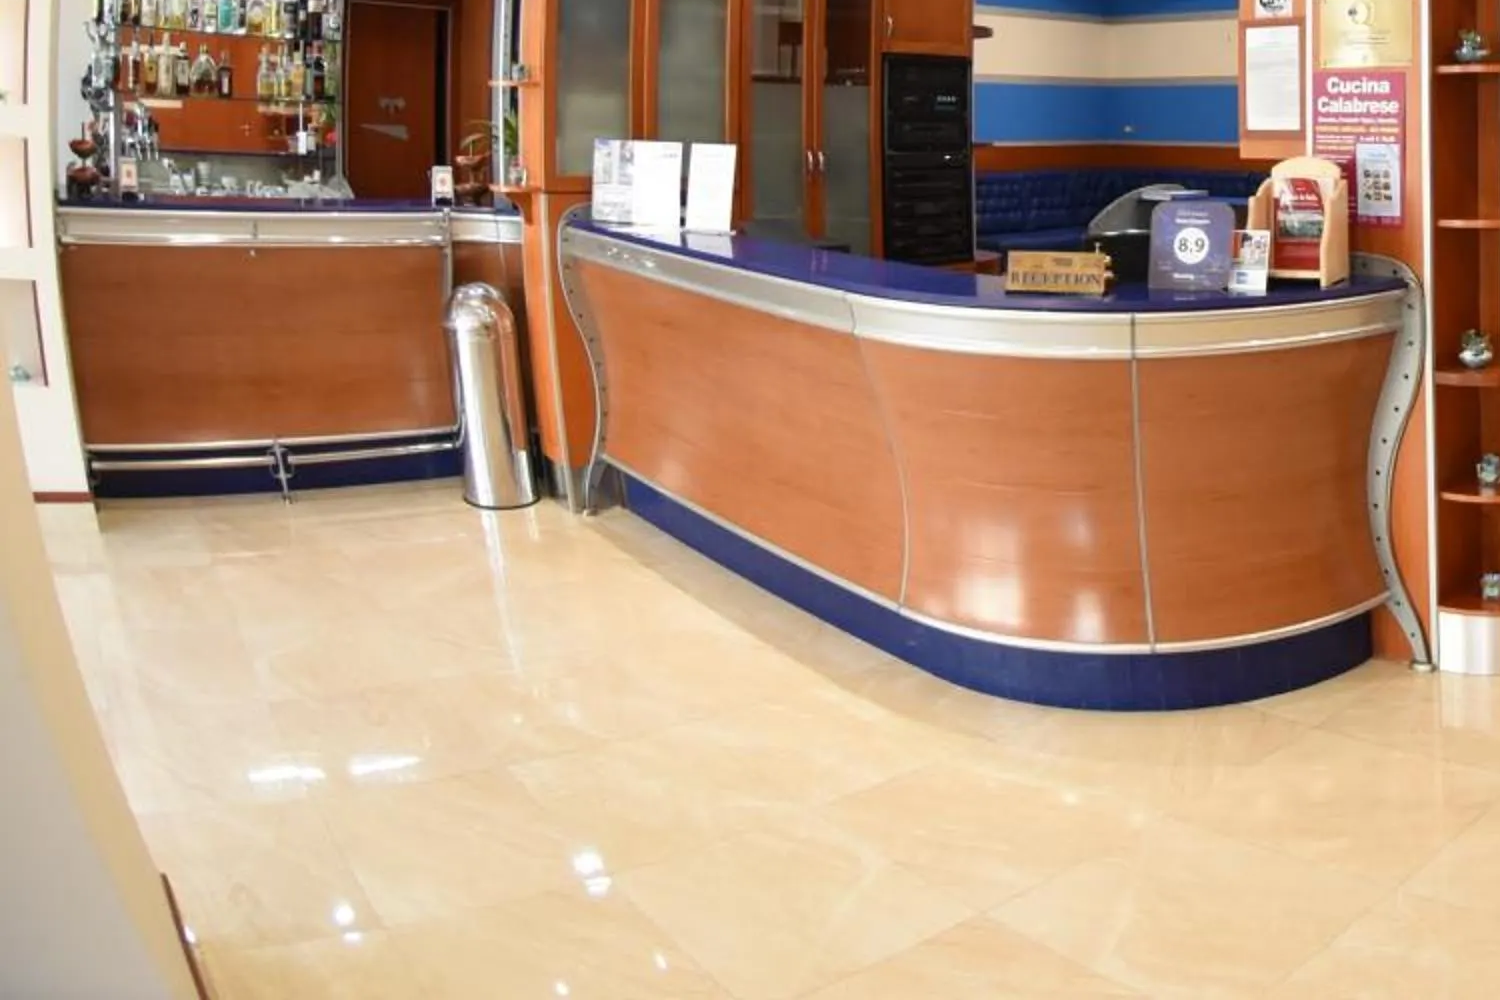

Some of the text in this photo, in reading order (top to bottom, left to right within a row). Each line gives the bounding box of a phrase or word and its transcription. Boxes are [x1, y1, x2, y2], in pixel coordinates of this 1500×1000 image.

[1326, 77, 1390, 94] Cucina
[1318, 96, 1399, 114] Calabrese
[1011, 271, 1100, 284] RECEPTION
